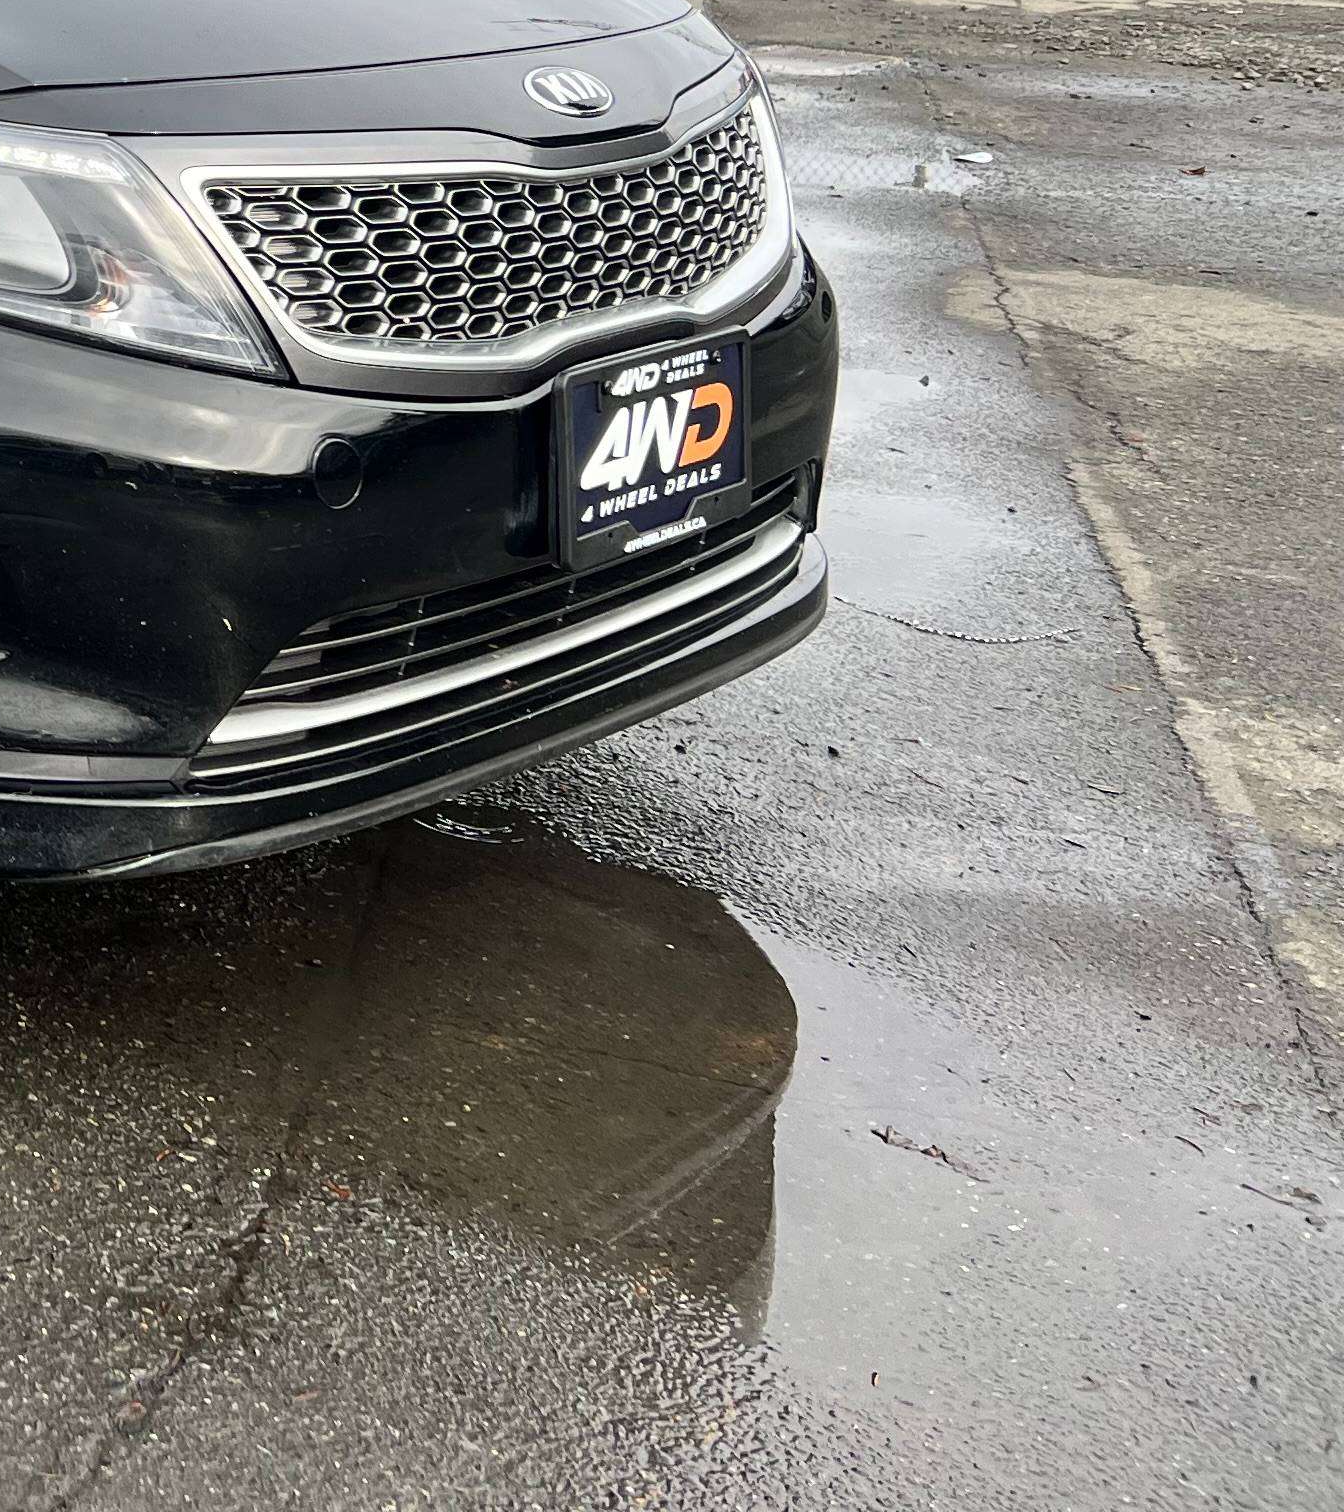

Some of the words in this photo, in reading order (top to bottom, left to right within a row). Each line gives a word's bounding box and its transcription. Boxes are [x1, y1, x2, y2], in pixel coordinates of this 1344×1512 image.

[534, 71, 609, 105] KIA
[611, 362, 661, 397] 4WD
[661, 359, 670, 371] 4
[672, 349, 709, 369] WHEEL
[666, 363, 705, 384] DEALS
[580, 382, 734, 492] 4WD
[580, 505, 594, 523] 4
[599, 484, 658, 518] WHEEL
[664, 462, 723, 496] DEALS
